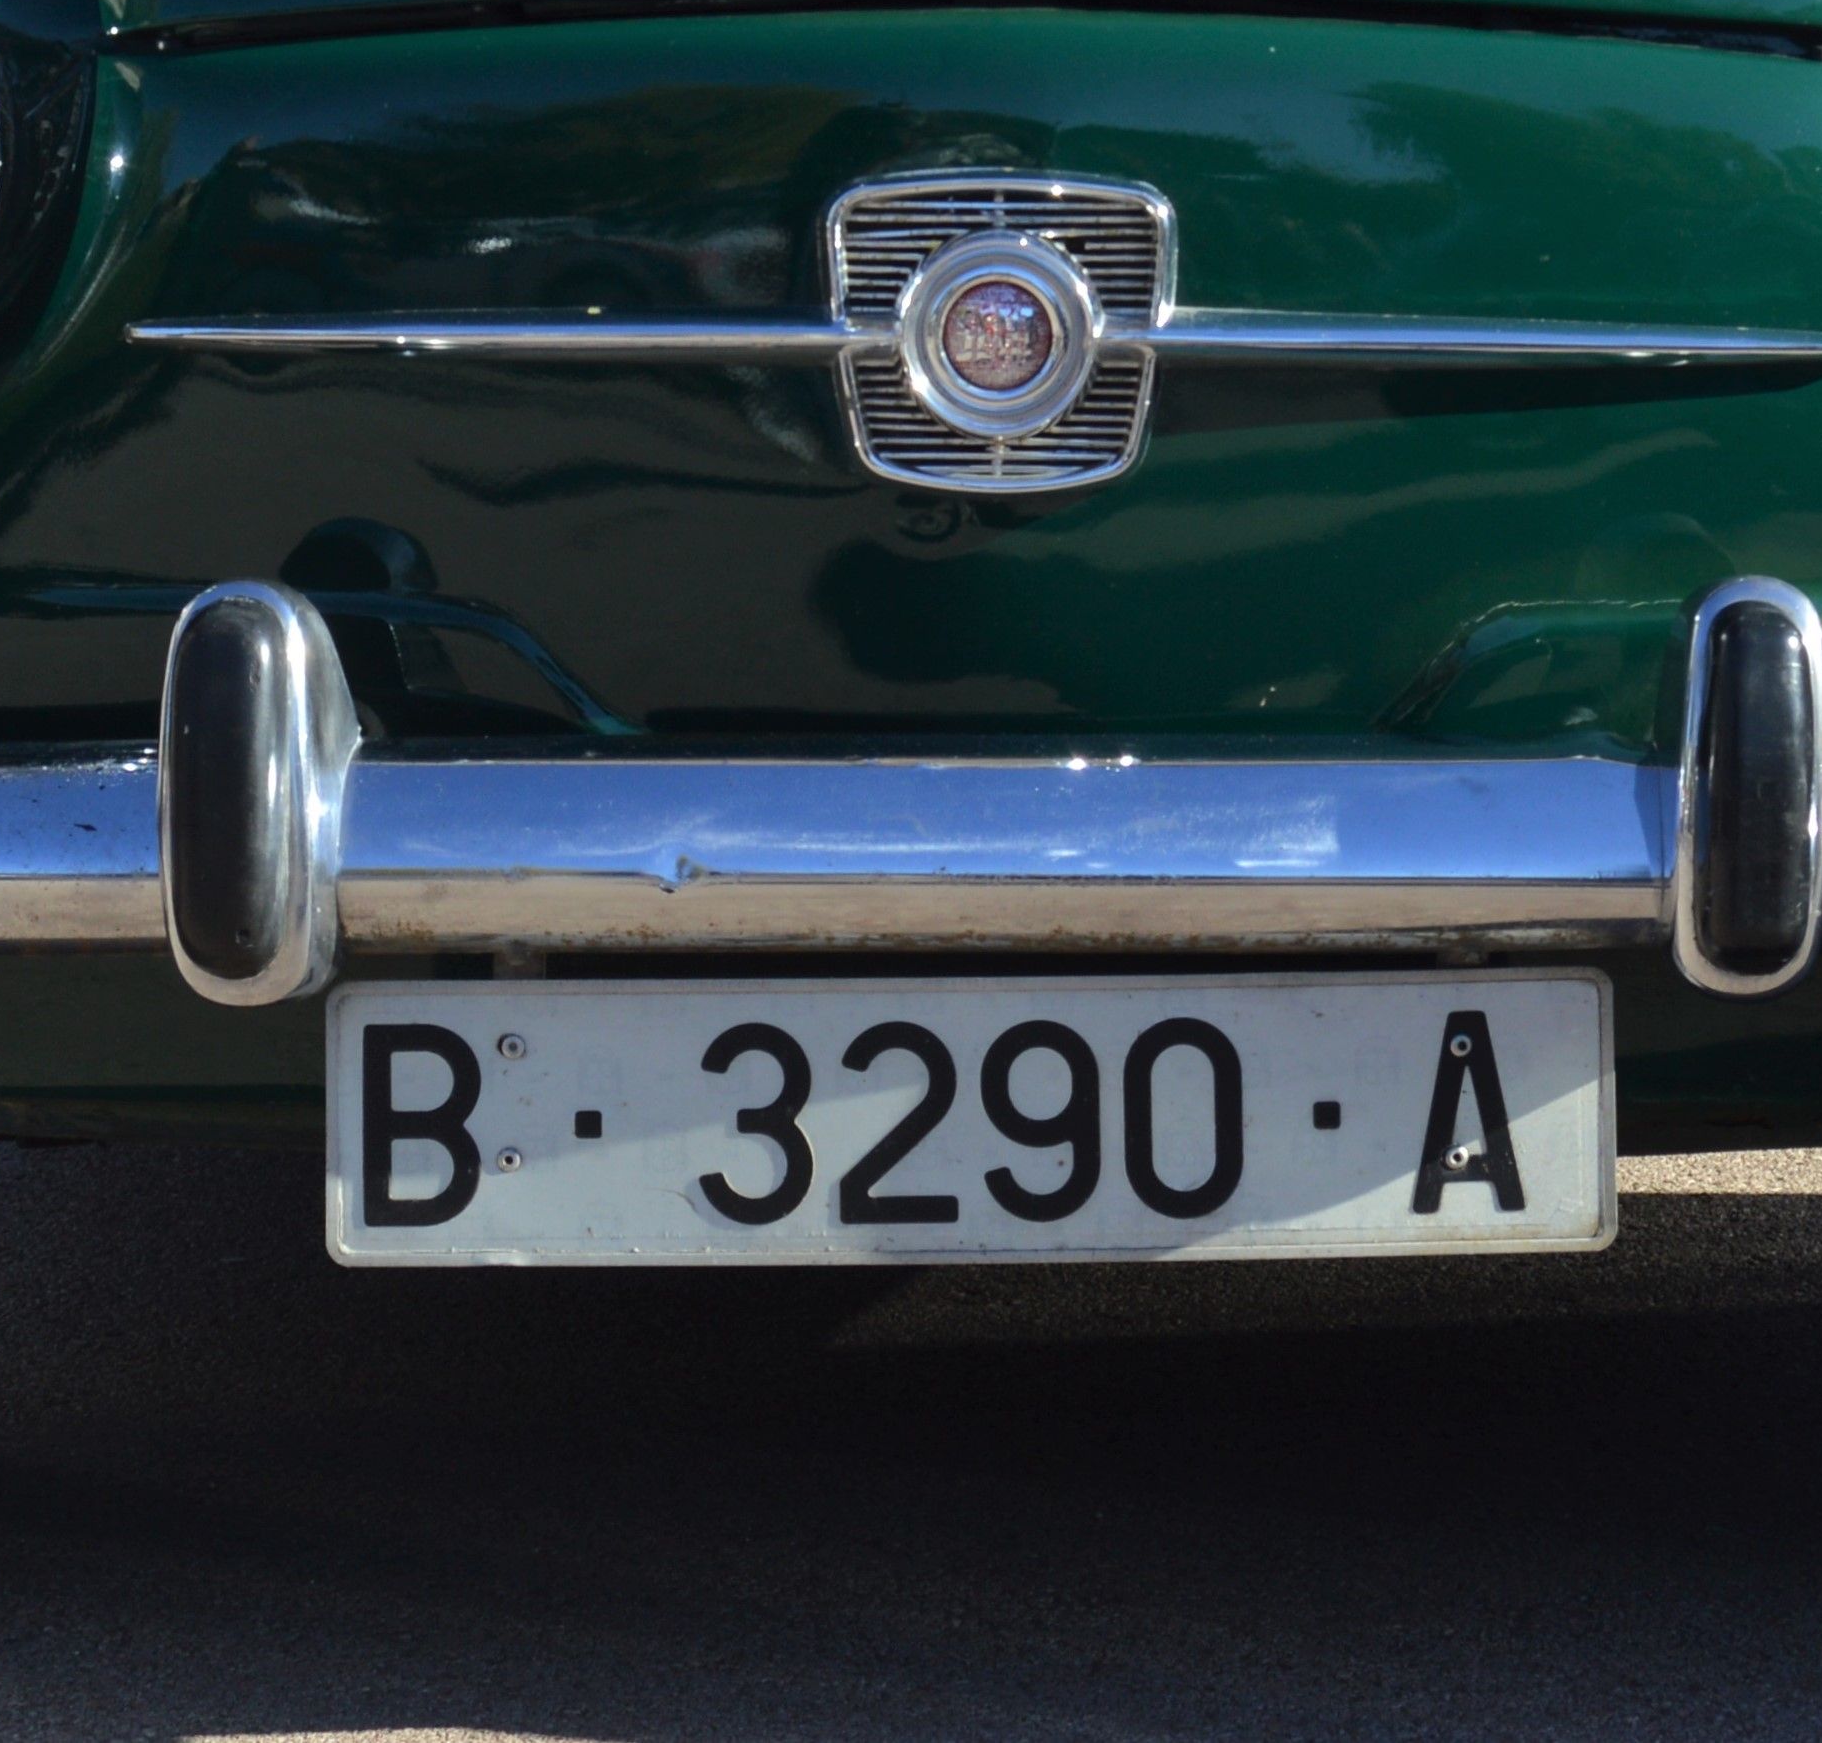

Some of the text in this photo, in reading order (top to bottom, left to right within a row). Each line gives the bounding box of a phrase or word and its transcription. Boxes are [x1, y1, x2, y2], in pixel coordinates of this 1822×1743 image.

[363, 1023, 482, 1228] B
[699, 1016, 1245, 1225] 3290
[1412, 1009, 1527, 1215] A
